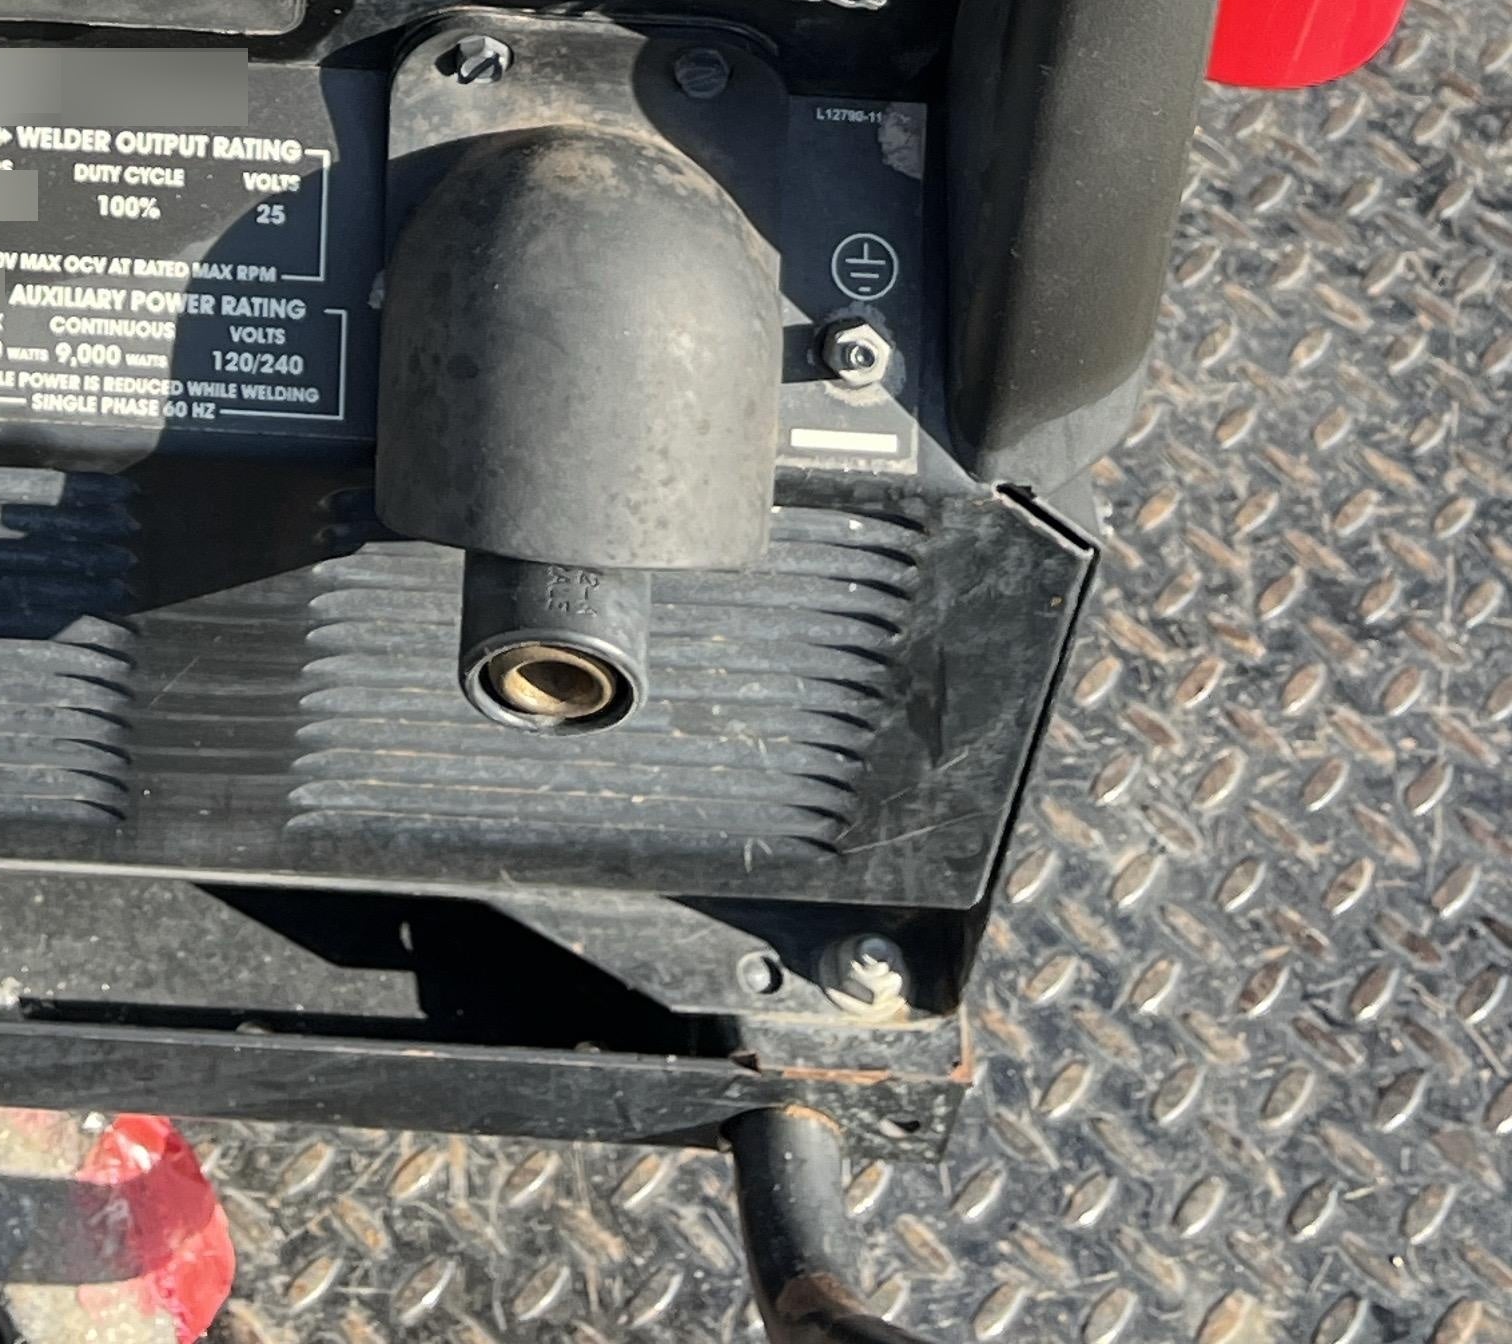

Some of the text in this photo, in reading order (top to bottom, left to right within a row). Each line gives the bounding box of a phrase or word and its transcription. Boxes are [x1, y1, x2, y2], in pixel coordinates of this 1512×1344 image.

[15, 125, 303, 163] WELDER OUTPUT RATING
[73, 162, 186, 188] DUTY CYCLE
[242, 171, 302, 193] VOLTS
[96, 193, 162, 220] 100%
[255, 203, 287, 225] 25
[19, 252, 63, 273] MAX
[63, 254, 108, 275] OCV
[107, 257, 133, 276] AT
[133, 258, 191, 279] RATED
[191, 261, 234, 281] MAX
[235, 264, 278, 283] RPM
[8, 283, 307, 320] AUXILIARY POWER RATING
[49, 315, 177, 340] CONTINUOUS
[228, 324, 287, 345] VOLTS
[6, 346, 50, 362] WATTS
[54, 341, 122, 368] 9,000
[125, 352, 169, 369] WATTS
[211, 350, 305, 375] 120/240
[18, 371, 81, 391] POWER
[83, 374, 101, 392] IS
[103, 375, 185, 397] REDUCED
[186, 380, 239, 399] WHILE
[240, 383, 320, 404] WELDING
[31, 392, 217, 420] SINGLE PHASE 60 HZ
